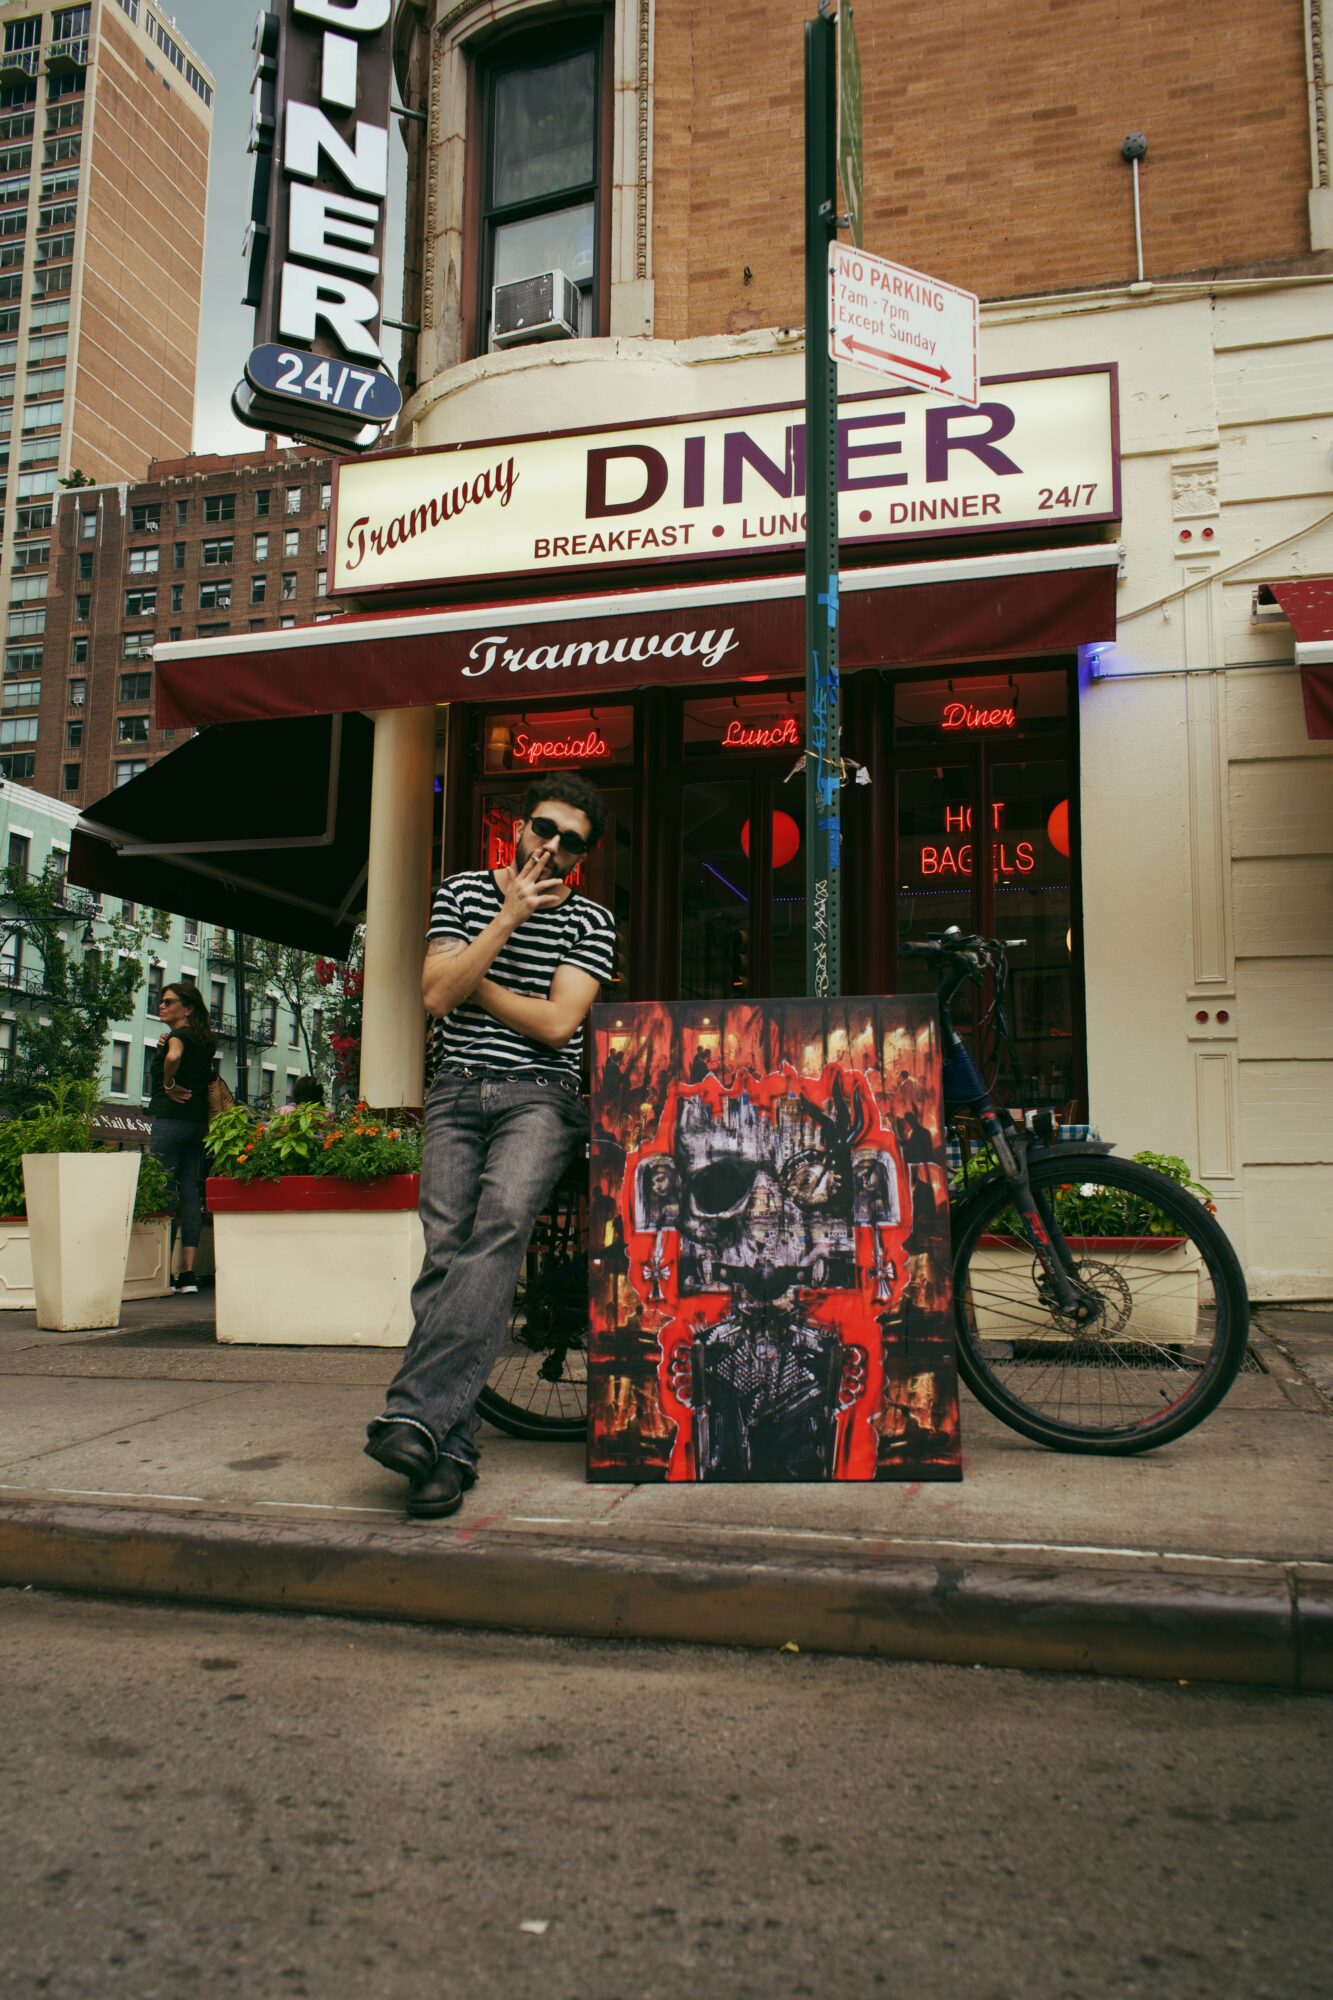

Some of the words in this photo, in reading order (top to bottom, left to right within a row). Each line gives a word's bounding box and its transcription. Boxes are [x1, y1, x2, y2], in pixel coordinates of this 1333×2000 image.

[839, 256, 864, 282] NO
[870, 268, 944, 312] PARKING
[839, 283, 868, 308] 7am
[881, 298, 909, 322] 7pm
[839, 305, 885, 336] Except
[890, 323, 937, 356] Sunday
[275, 352, 376, 410] 24/7
[345, 456, 520, 570] Tramway
[585, 401, 1024, 519] DINER
[534, 523, 695, 559] BREAKFAST
[742, 511, 807, 539] LUN
[890, 493, 1002, 524] DINNER
[1038, 483, 1098, 511] 24/7
[461, 627, 739, 677] Tramway
[721, 719, 799, 747] Lunch
[942, 703, 1015, 728] Diner
[513, 731, 608, 764] Specials
[945, 803, 1005, 832] HT
[100, 1115, 126, 1130] Nail
[136, 1118, 153, 1135] Sp
